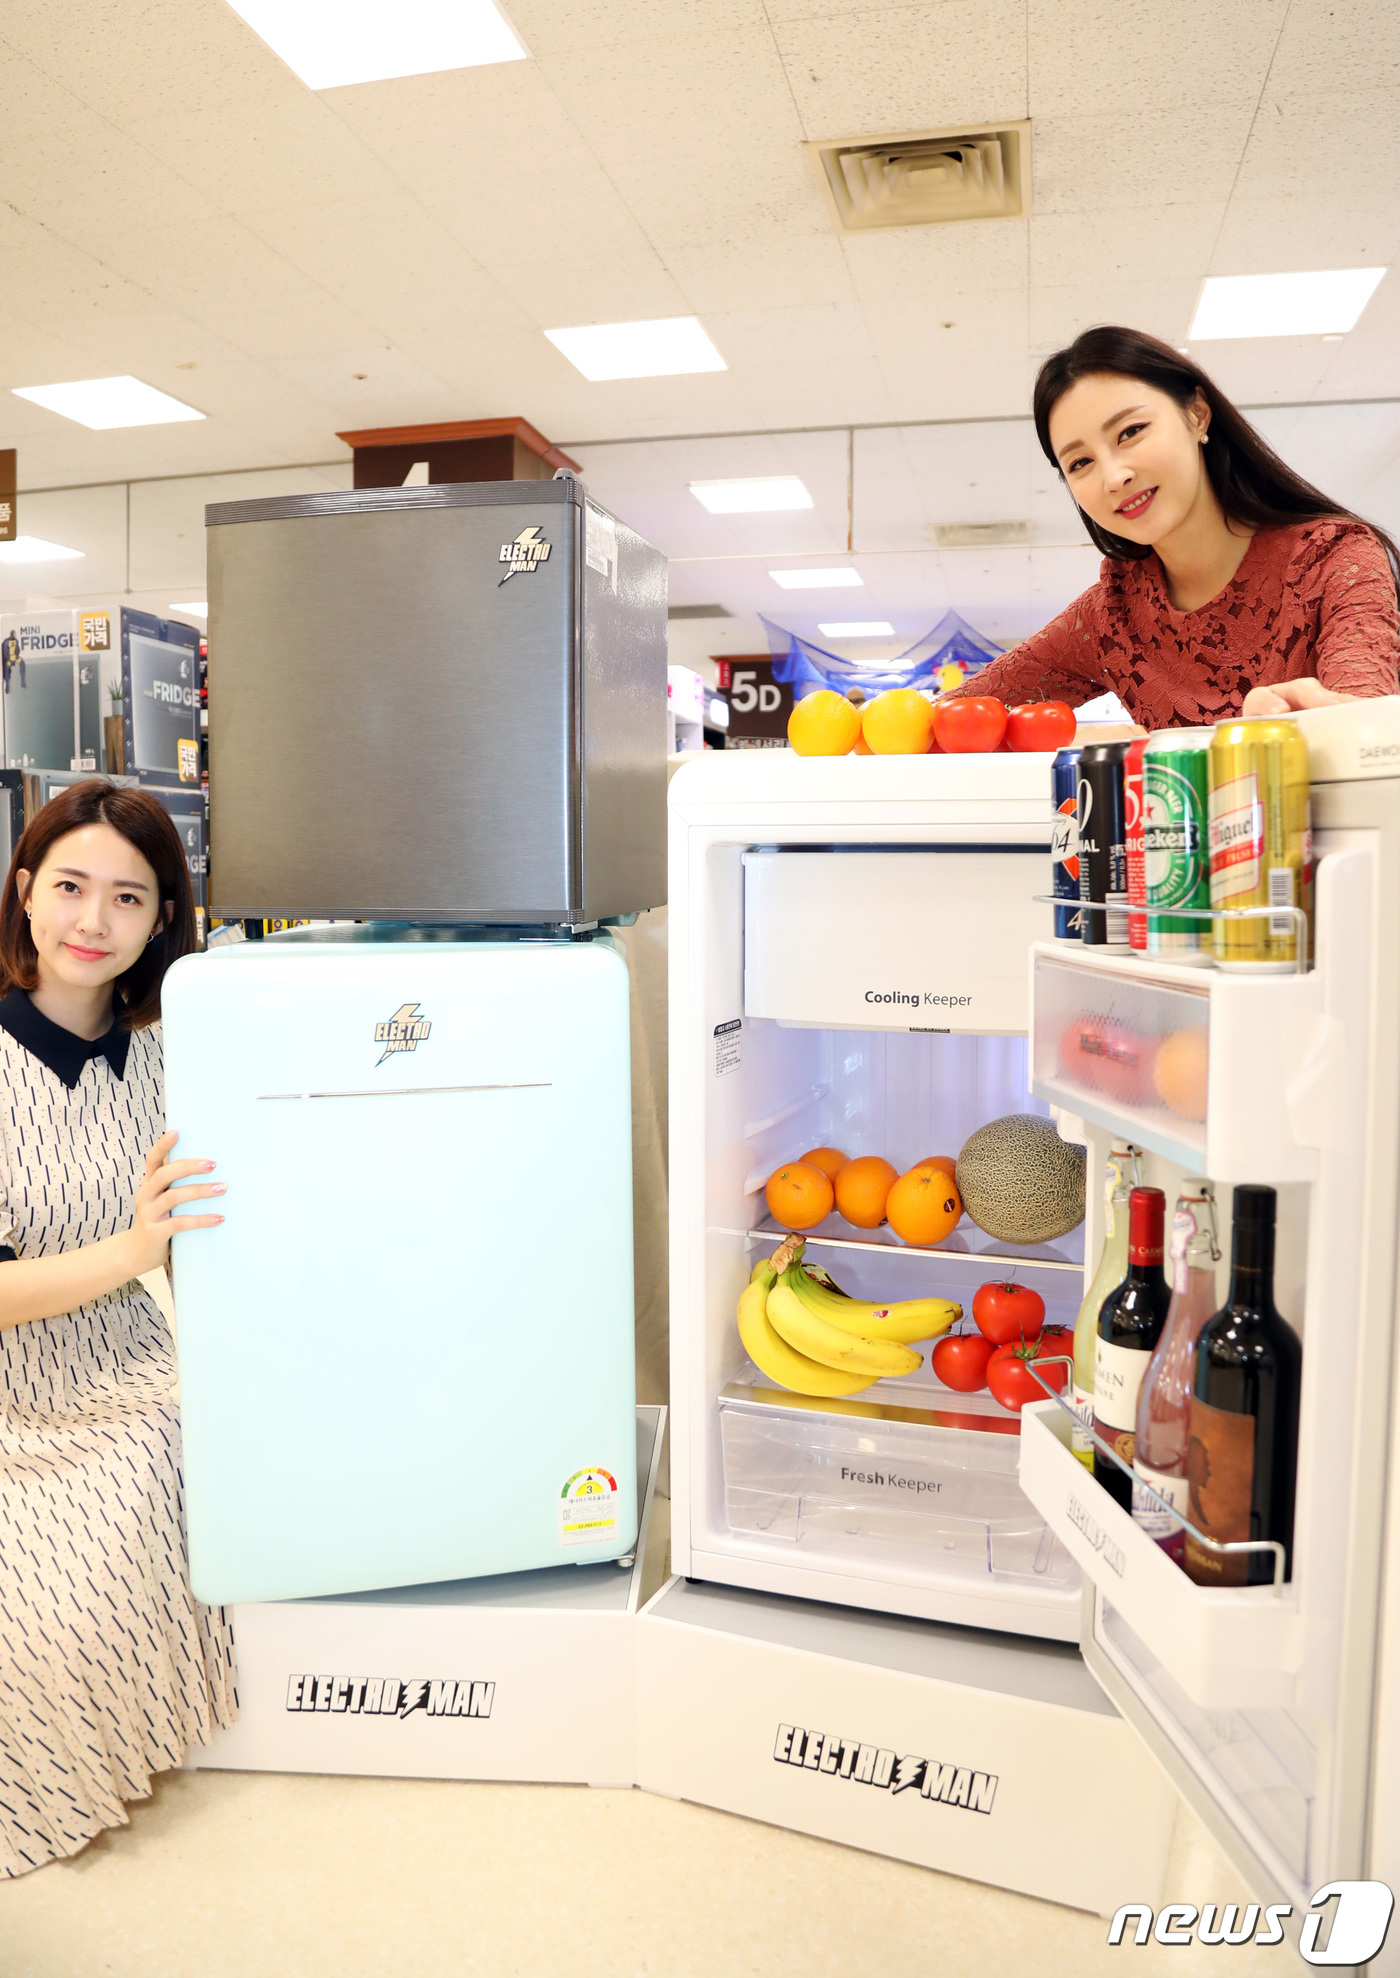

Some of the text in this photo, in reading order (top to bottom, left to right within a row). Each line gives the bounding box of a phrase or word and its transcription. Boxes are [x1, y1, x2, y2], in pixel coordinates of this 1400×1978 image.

[499, 543, 552, 562] ELECTRO
[510, 560, 538, 573] MAN
[20, 625, 40, 635] MINI
[82, 617, 107, 632] 국민
[84, 631, 107, 647] 가격
[153, 679, 200, 708] FRIDGE
[731, 670, 782, 713] 5D
[180, 745, 196, 761] 국민
[181, 761, 197, 778] 가격
[864, 990, 973, 1008] Cooling Keeper
[375, 1021, 432, 1042] ELECTRO
[386, 1039, 418, 1052] MAN
[841, 1467, 943, 1493] Fresh Keeper
[586, 1485, 593, 1494] 3
[286, 1674, 496, 1718] ELECTRO MAN
[773, 1723, 999, 1815] ELECTRO MAN
